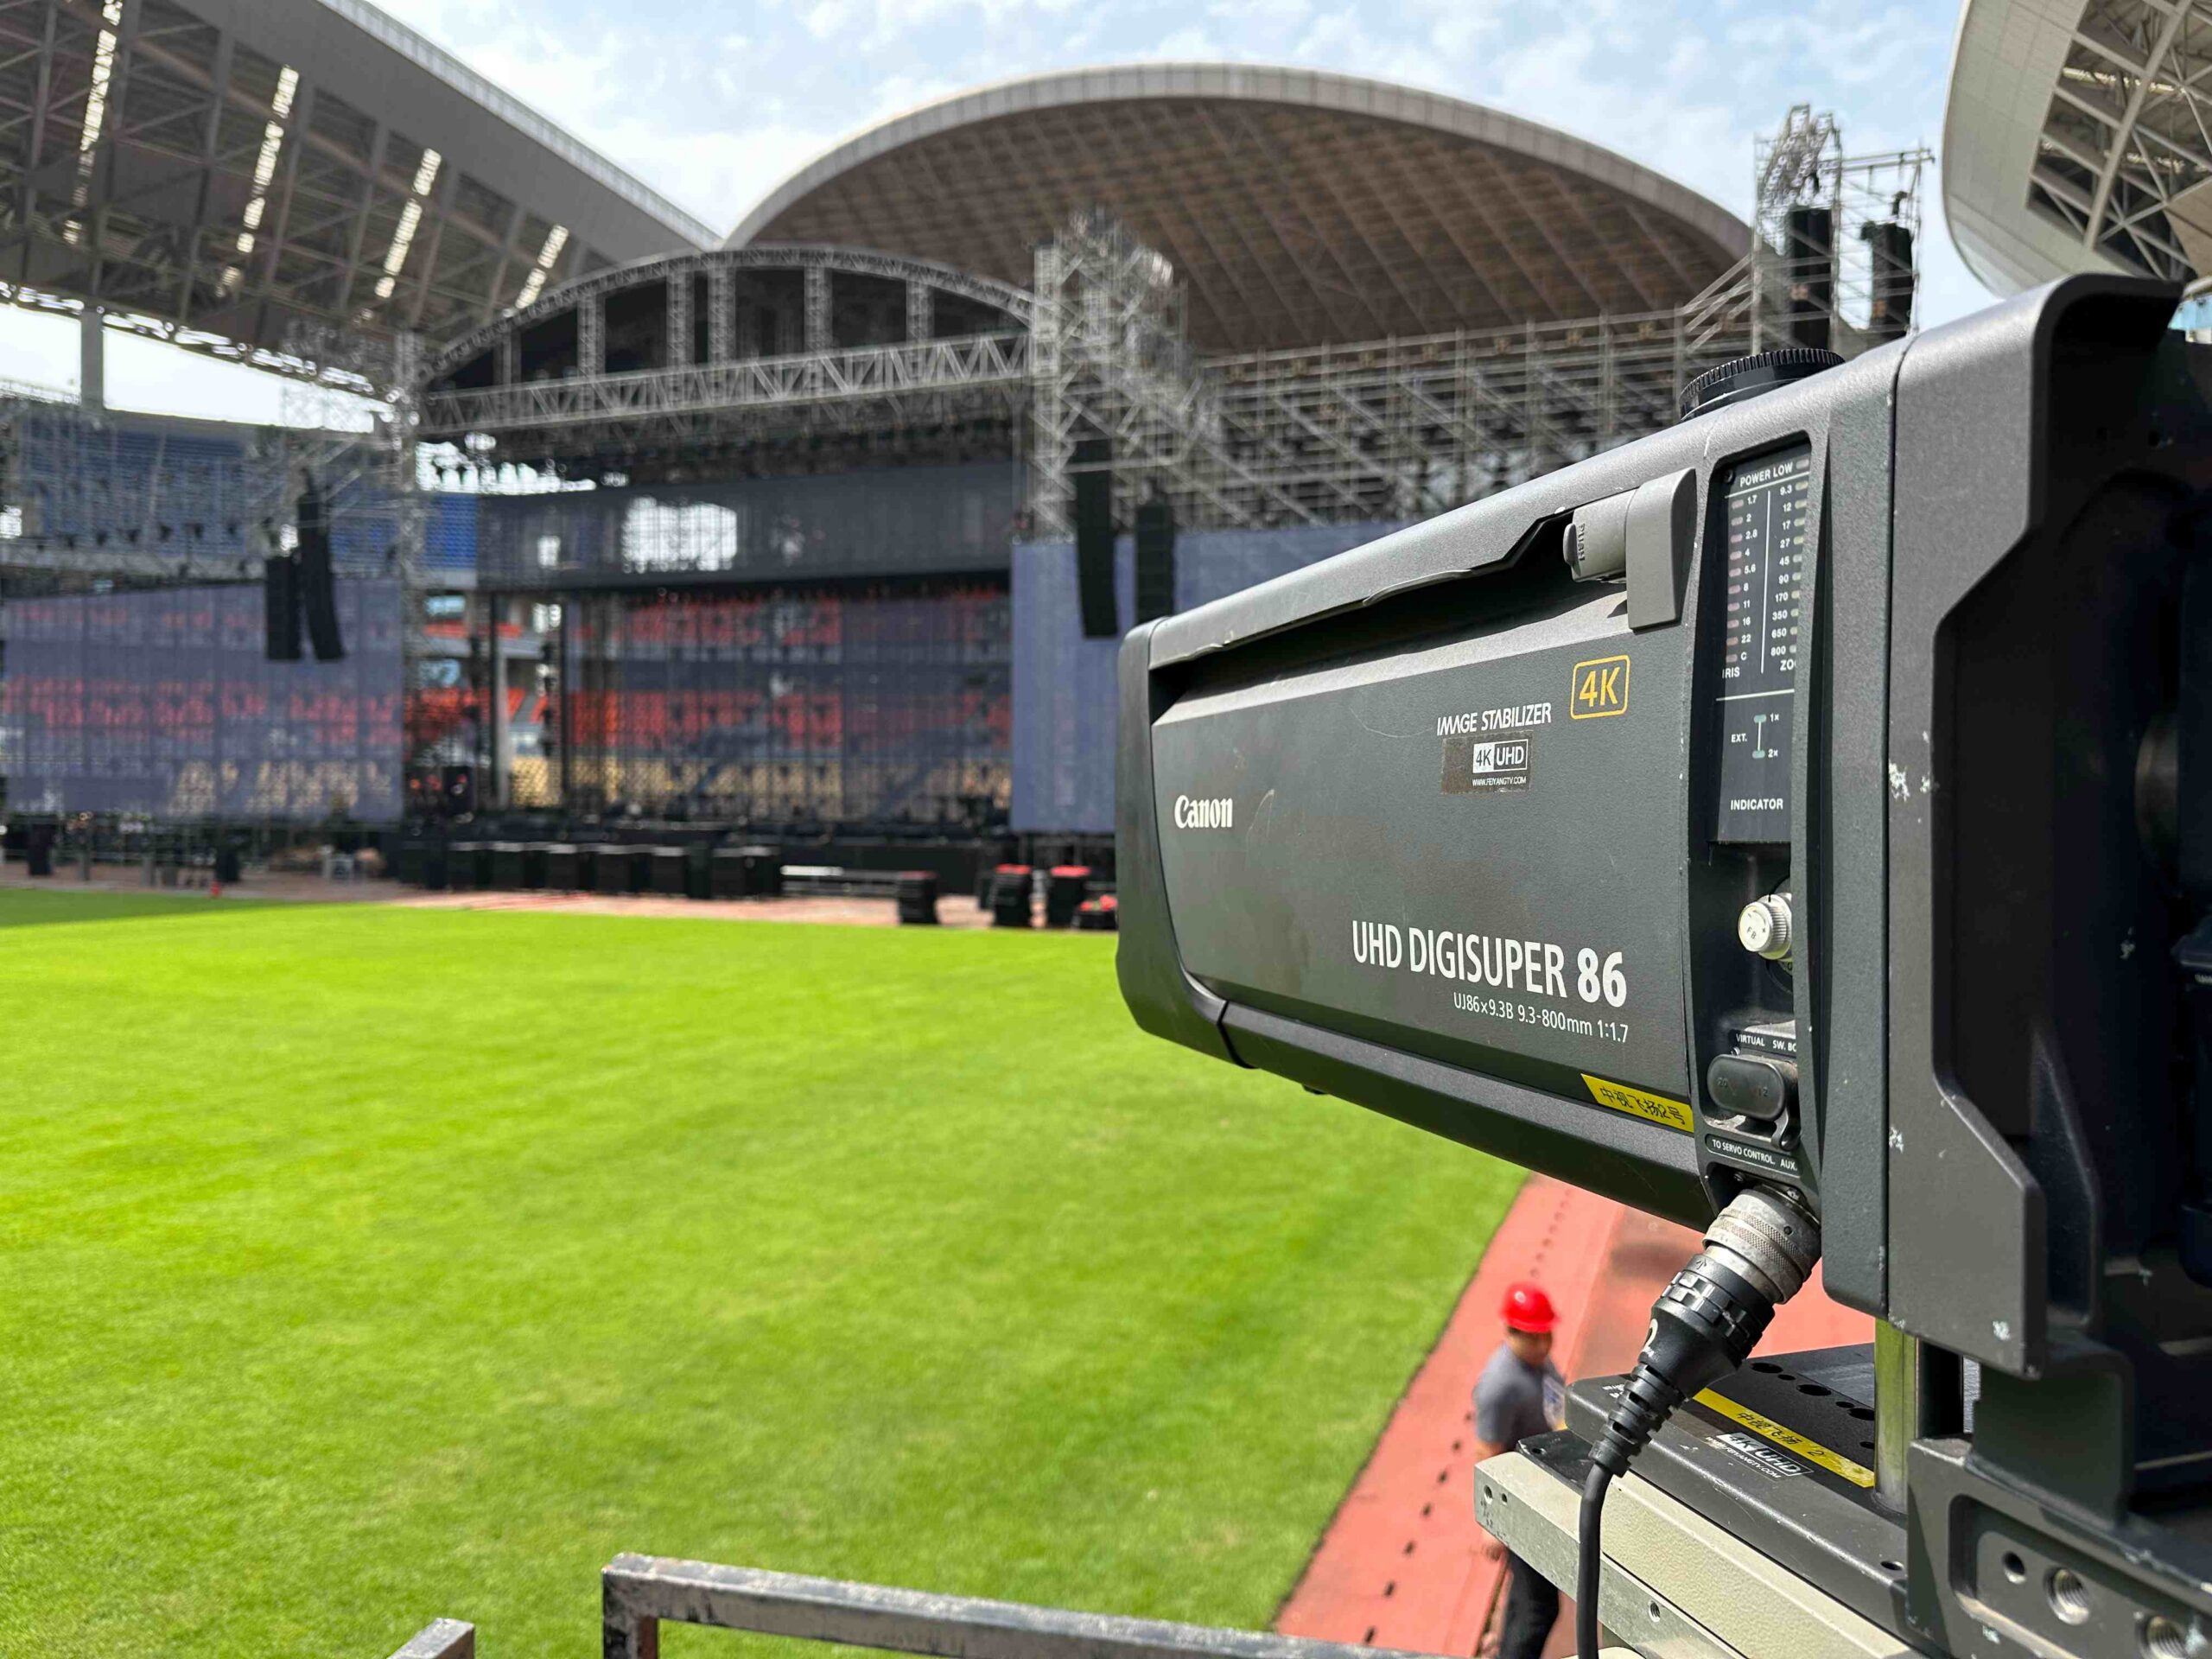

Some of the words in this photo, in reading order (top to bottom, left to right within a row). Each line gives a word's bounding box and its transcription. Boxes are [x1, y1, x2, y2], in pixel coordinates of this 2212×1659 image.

[1739, 468, 1771, 487] POWER
[1773, 461, 1793, 478] LOW
[1780, 485, 1793, 496] 9.3
[1747, 494, 1758, 505] 1.7
[1783, 502, 1792, 512] 12
[1746, 513, 1751, 523] 2
[1782, 520, 1791, 531] 17
[1745, 529, 1758, 540] 2.8
[1780, 537, 1790, 549] 27
[1745, 548, 1751, 556] 4
[1779, 556, 1789, 566] 45
[1744, 563, 1756, 575] 5.6
[1778, 574, 1789, 584] 90
[1743, 582, 1749, 592] 8
[1775, 592, 1789, 602] 170
[1743, 600, 1751, 608] 11
[1772, 609, 1788, 620] 350
[1743, 616, 1751, 626] 16
[1741, 633, 1751, 644] 22
[1771, 627, 1787, 639] 650
[1740, 652, 1747, 660] C
[1770, 645, 1786, 657] 800
[1780, 658, 1796, 671] ZO
[1722, 666, 1740, 679] IRIS
[1579, 666, 1621, 708] 4K
[1437, 712, 1478, 736] IMAGE
[1481, 702, 1552, 731] STABILIZER
[1731, 733, 1748, 743] EXT.
[1475, 748, 1492, 766] 4K
[1496, 746, 1524, 766] UHD
[1730, 798, 1783, 810] INDICATOR
[1174, 795, 1233, 829] Canon
[1352, 920, 1402, 969] UHD
[1408, 927, 1567, 998] DIGISUPER
[1577, 947, 1627, 1007] 86
[1453, 992, 1513, 1020] UJ86x9.3B
[1518, 1003, 1592, 1037] 9.3-800mm
[1597, 1019, 1629, 1044] 1:1.7
[1736, 1033, 1765, 1046] VIRTUAL
[1772, 1039, 1786, 1051] SW.
[1712, 1139, 1721, 1149] TO
[1722, 1141, 1742, 1155] SERVO
[1780, 1159, 1797, 1171] AUX.
[1730, 1435, 1758, 1448] 4K
[1755, 1448, 1802, 1472] UHD
